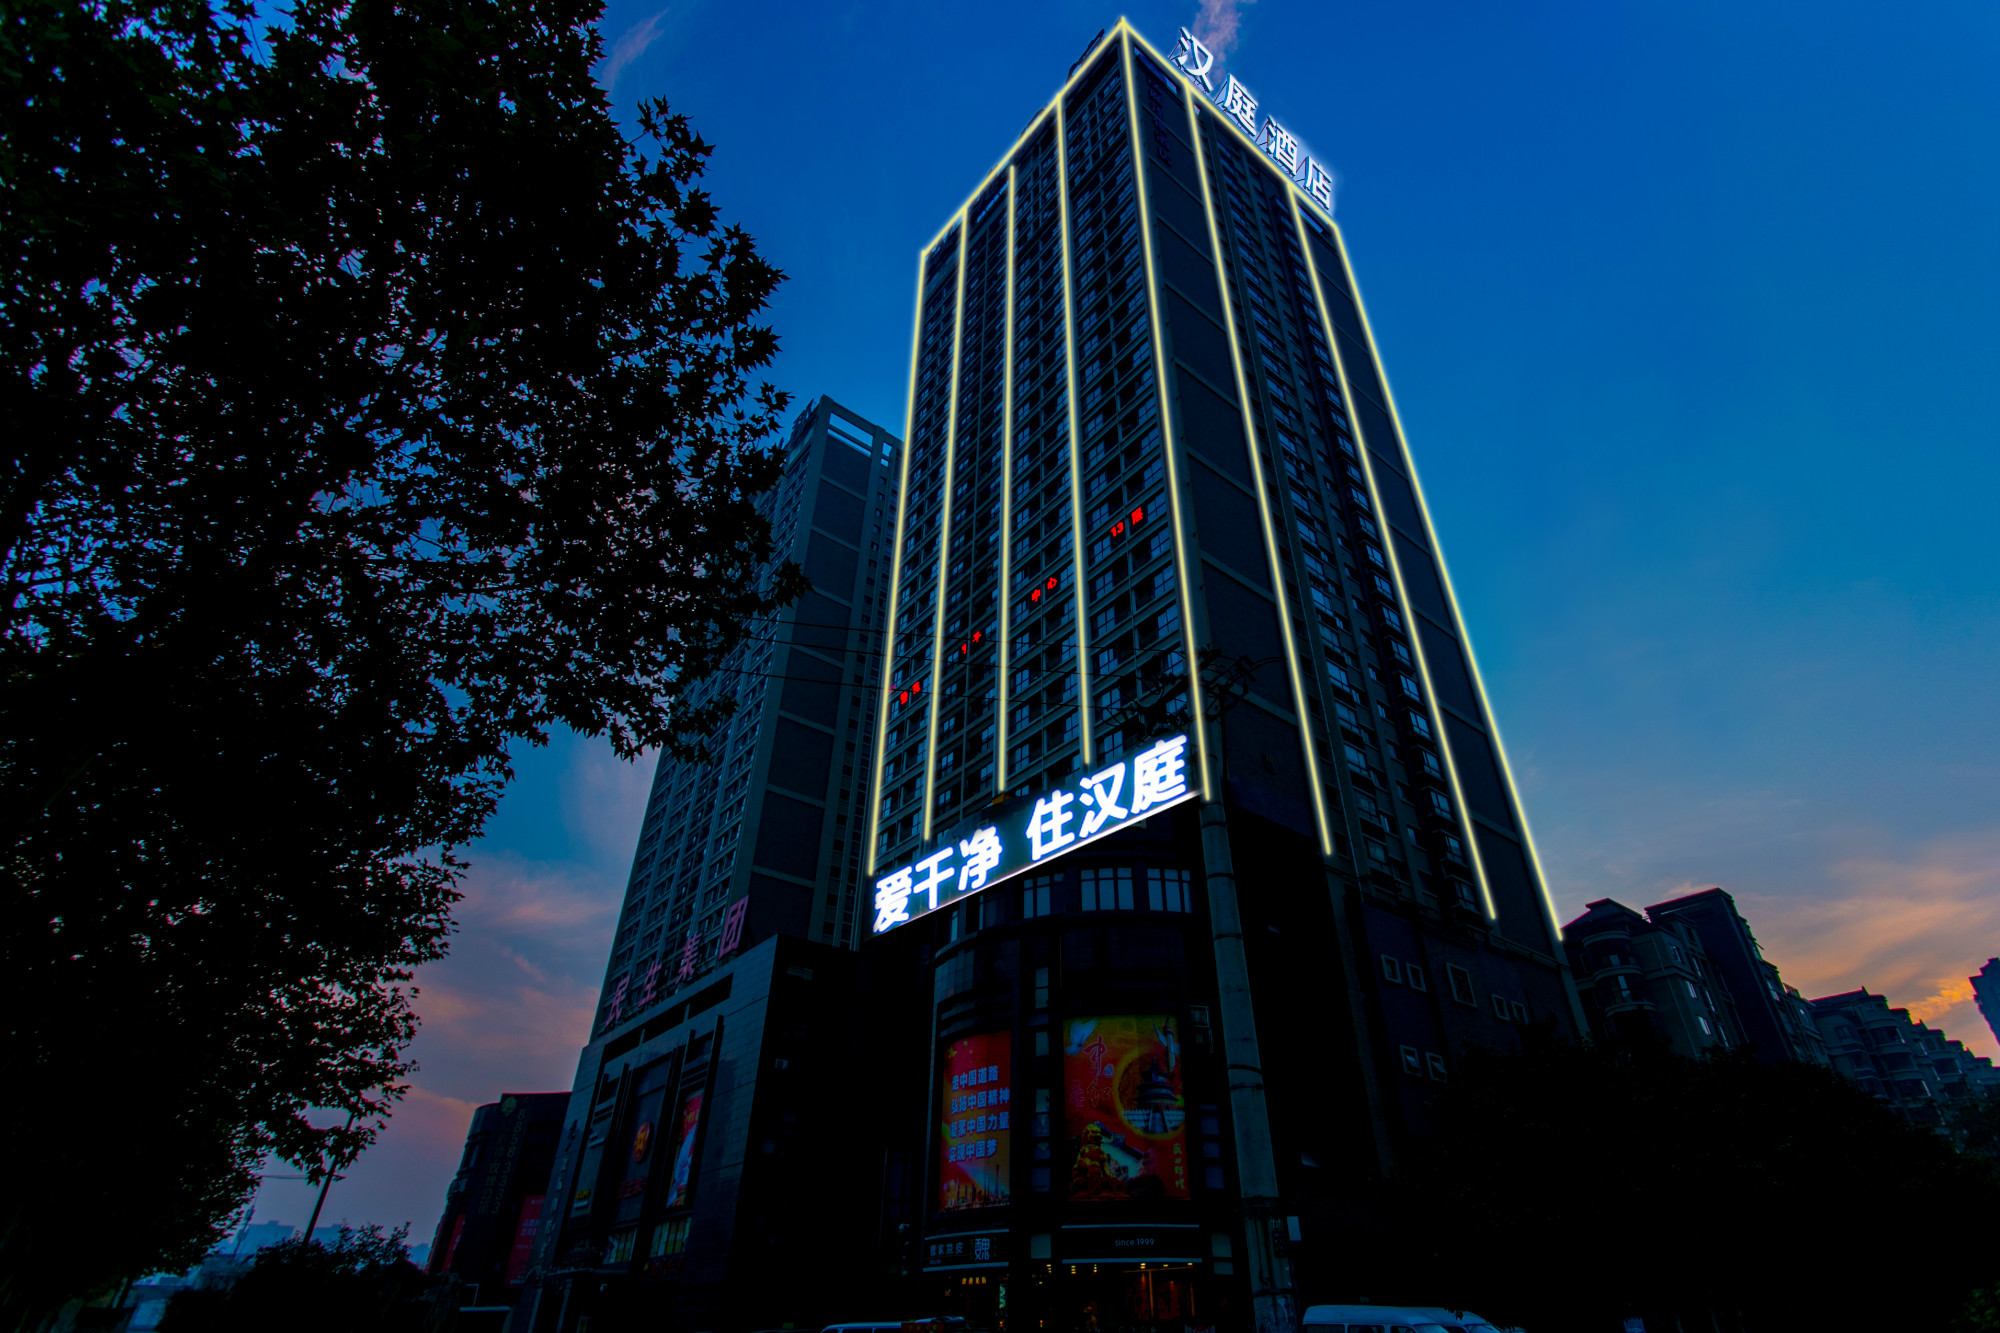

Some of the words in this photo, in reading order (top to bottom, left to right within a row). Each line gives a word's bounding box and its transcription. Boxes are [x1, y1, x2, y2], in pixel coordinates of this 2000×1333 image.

[1175, 26, 1333, 211] 汉庭酒店
[873, 825, 1004, 933] 爱干净
[1026, 734, 1190, 862] 住汉庭
[604, 895, 750, 1027] 民生集团
[951, 1065, 999, 1091] 走中国道路
[950, 1087, 1010, 1114] 弘扬中国精神
[949, 1111, 1010, 1138] 凝聚中国力量
[948, 1138, 998, 1162] 实现中国梦
[974, 1237, 990, 1261] 魏
[1114, 1237, 1136, 1247] since
[1136, 1237, 1156, 1247] 1999
